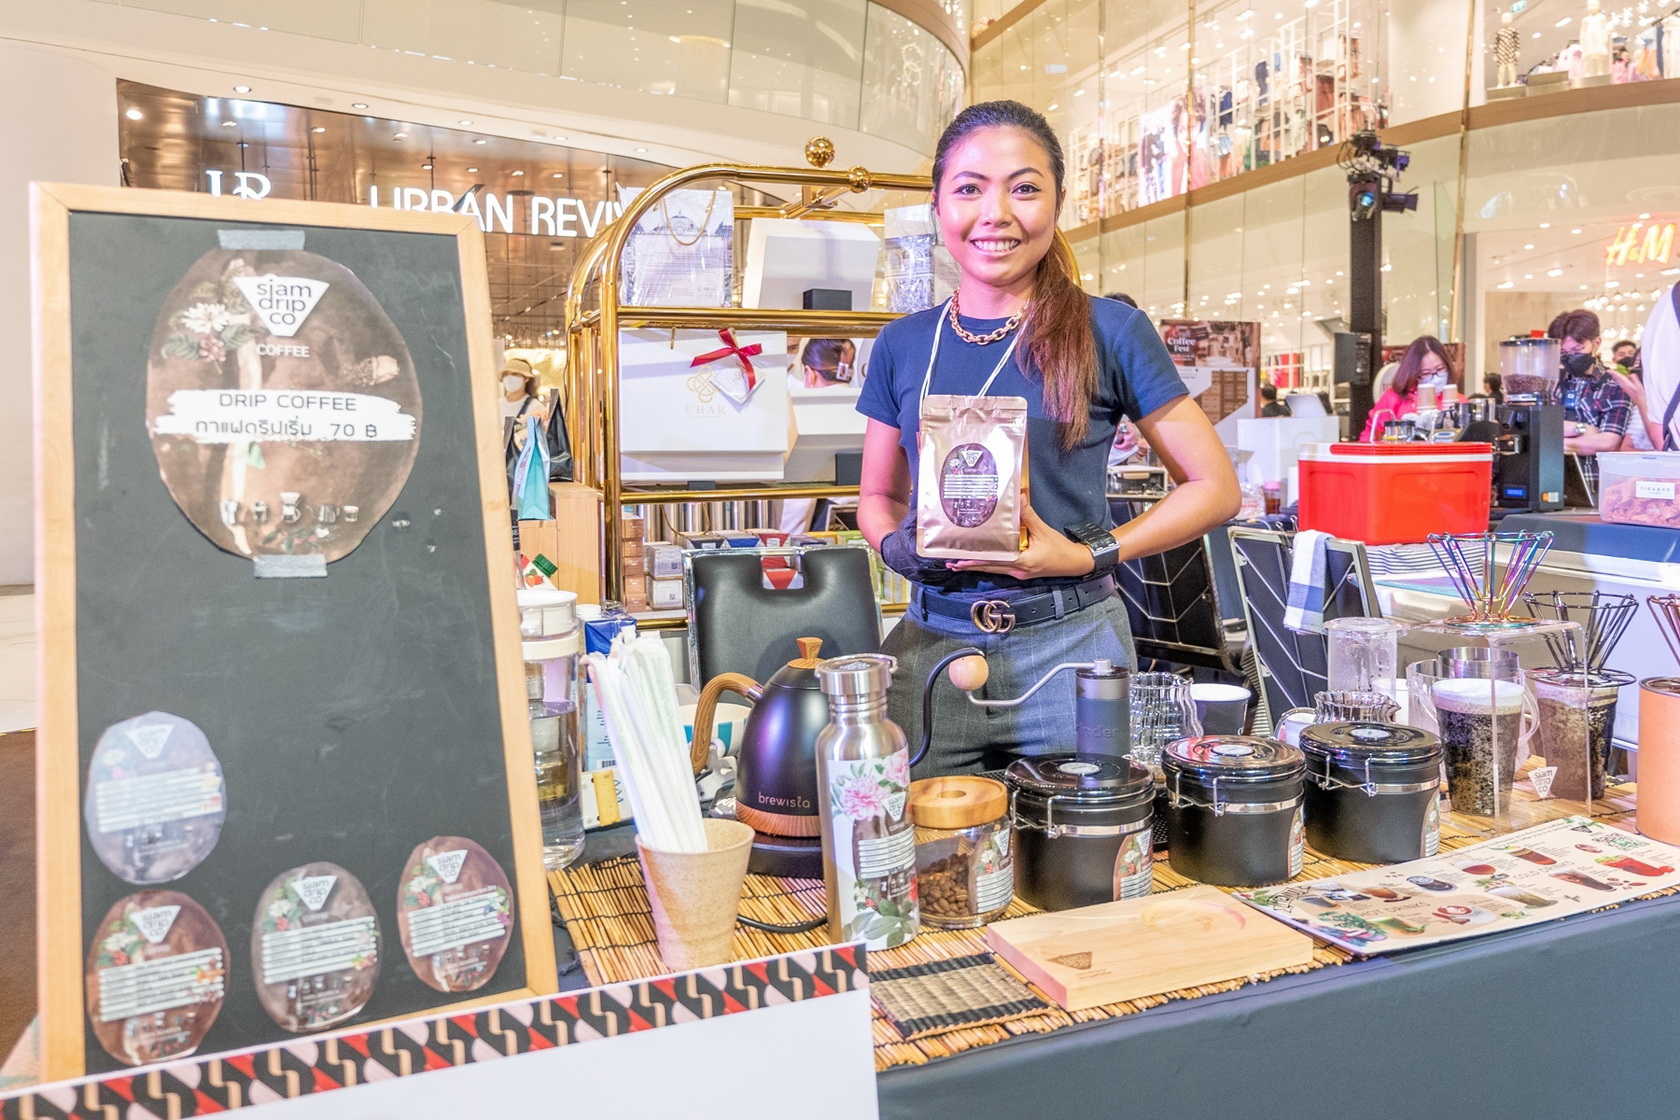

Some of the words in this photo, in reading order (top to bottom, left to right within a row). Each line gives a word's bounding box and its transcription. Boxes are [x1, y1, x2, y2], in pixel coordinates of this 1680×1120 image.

[531, 195, 624, 238] REVI
[1605, 223, 1677, 267] H&M
[257, 279, 312, 300] siam
[259, 297, 306, 313] drip
[269, 312, 296, 325] co
[1167, 337, 1196, 346] Coffee
[1174, 345, 1190, 353] Fest
[256, 343, 311, 358] COFFEE
[219, 393, 267, 408] DRIP
[277, 394, 357, 411] COFFEE
[685, 405, 727, 415] CHAR
[330, 423, 355, 437] 70
[758, 791, 811, 809] brewista
